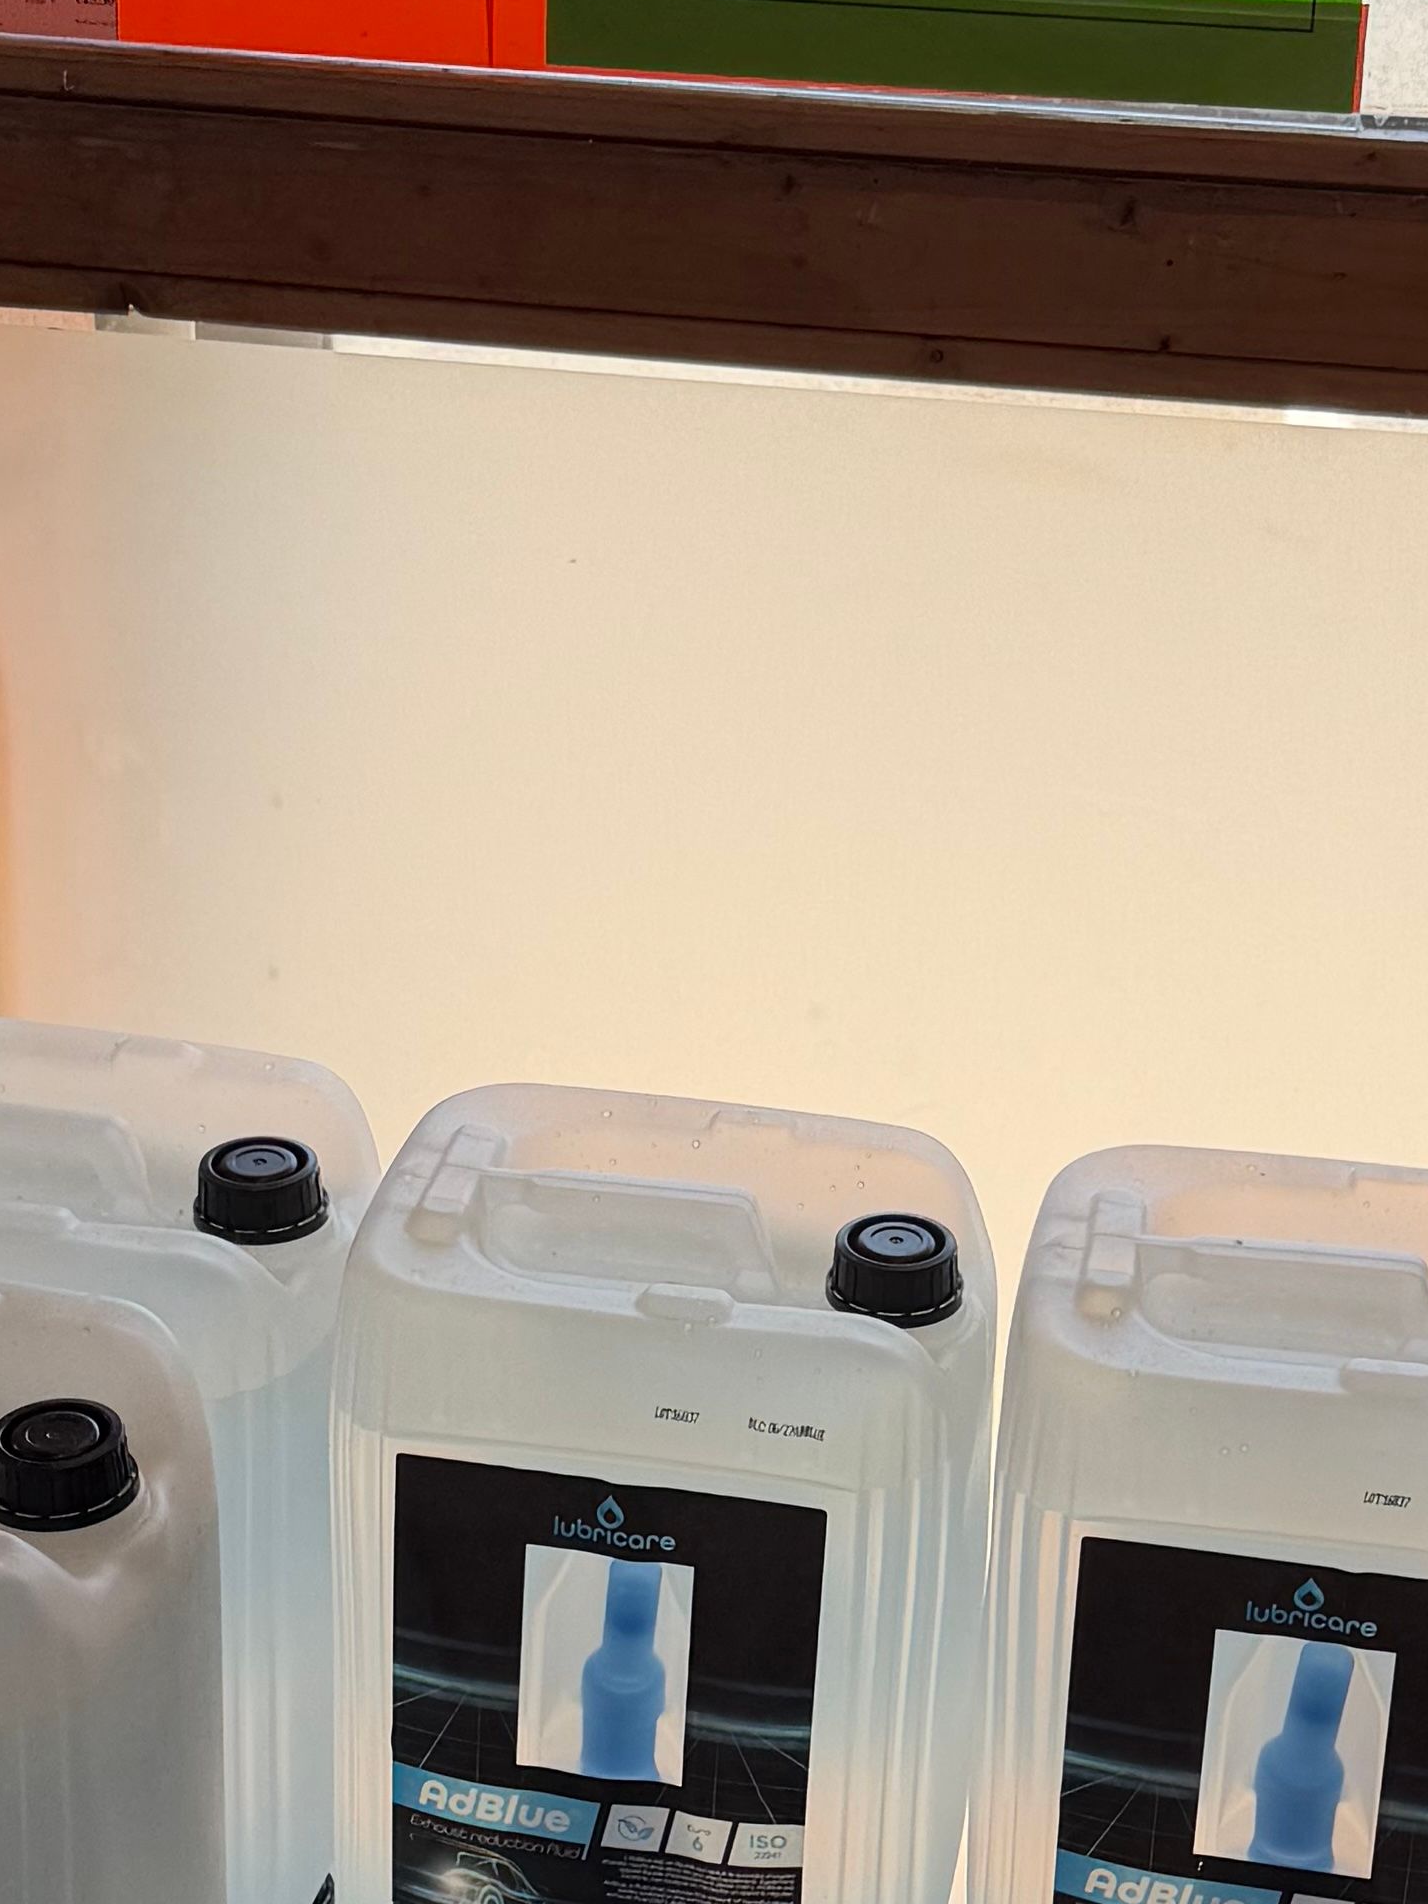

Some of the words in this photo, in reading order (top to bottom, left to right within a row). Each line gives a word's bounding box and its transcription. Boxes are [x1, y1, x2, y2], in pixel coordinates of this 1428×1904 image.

[552, 1510, 678, 1554] lubricare
[1244, 1599, 1379, 1640] lubricare
[417, 1778, 573, 1835] AdBlue
[409, 1813, 469, 1842] Exhaust
[470, 1828, 545, 1856] reduction
[545, 1840, 583, 1862] fluid
[748, 1832, 788, 1850] ISO
